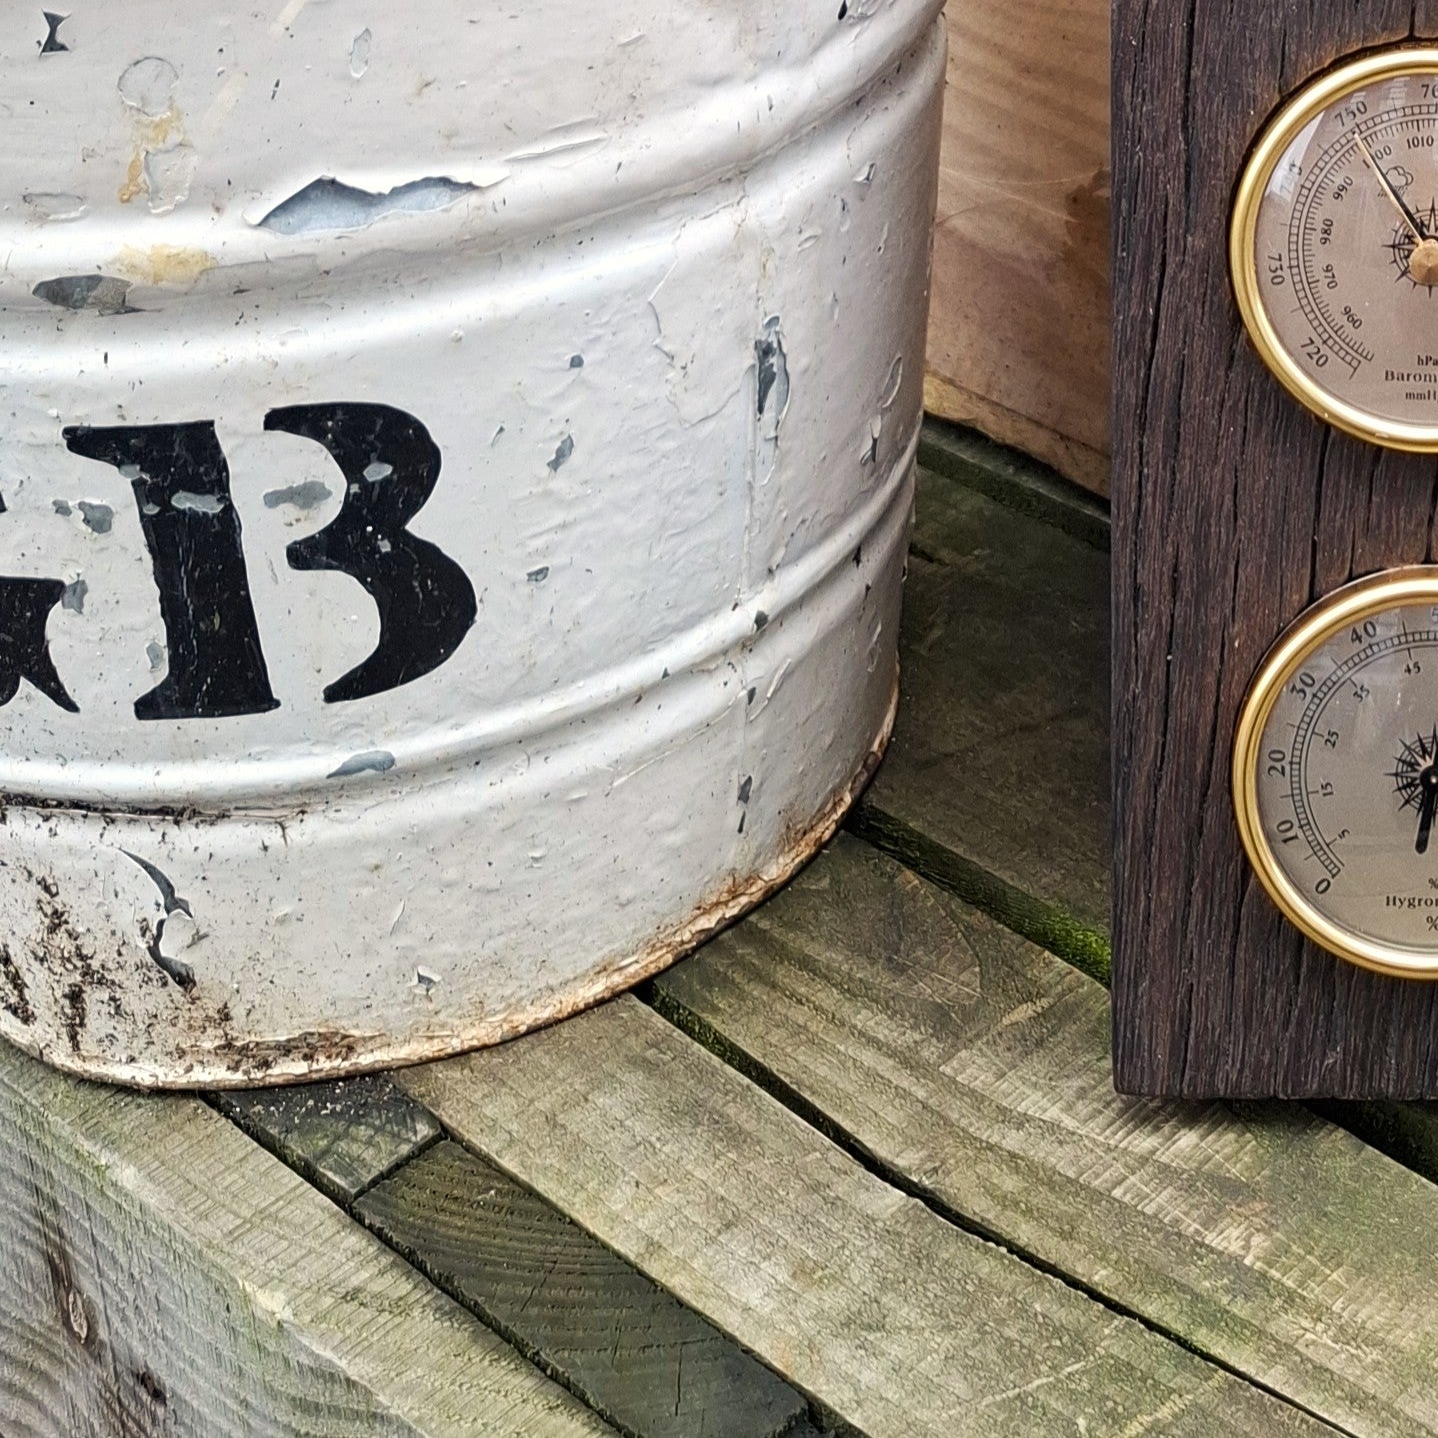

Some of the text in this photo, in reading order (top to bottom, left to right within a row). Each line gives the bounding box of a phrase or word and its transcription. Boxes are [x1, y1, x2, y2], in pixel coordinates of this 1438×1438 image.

[1335, 101, 1368, 127] 750
[1407, 135, 1434, 149] 1010
[1362, 144, 1391, 169] 100
[1332, 175, 1353, 202] 990
[1320, 218, 1333, 245] 980
[1267, 253, 1284, 285] 730
[1322, 264, 1338, 289] 970
[1341, 306, 1362, 329] 960
[1300, 337, 1328, 369] 720
[1417, 355, 1438, 366] hPa
[1350, 620, 1377, 644] 40
[1404, 663, 1420, 675] 45
[1291, 673, 1316, 700] 30
[1353, 684, 1370, 703] 35
[1324, 730, 1339, 748] 25
[1268, 750, 1286, 777] 20
[1321, 782, 1333, 797] 15
[1276, 820, 1298, 845] 10
[1339, 828, 1350, 840] 5
[1315, 878, 1330, 894] 0
